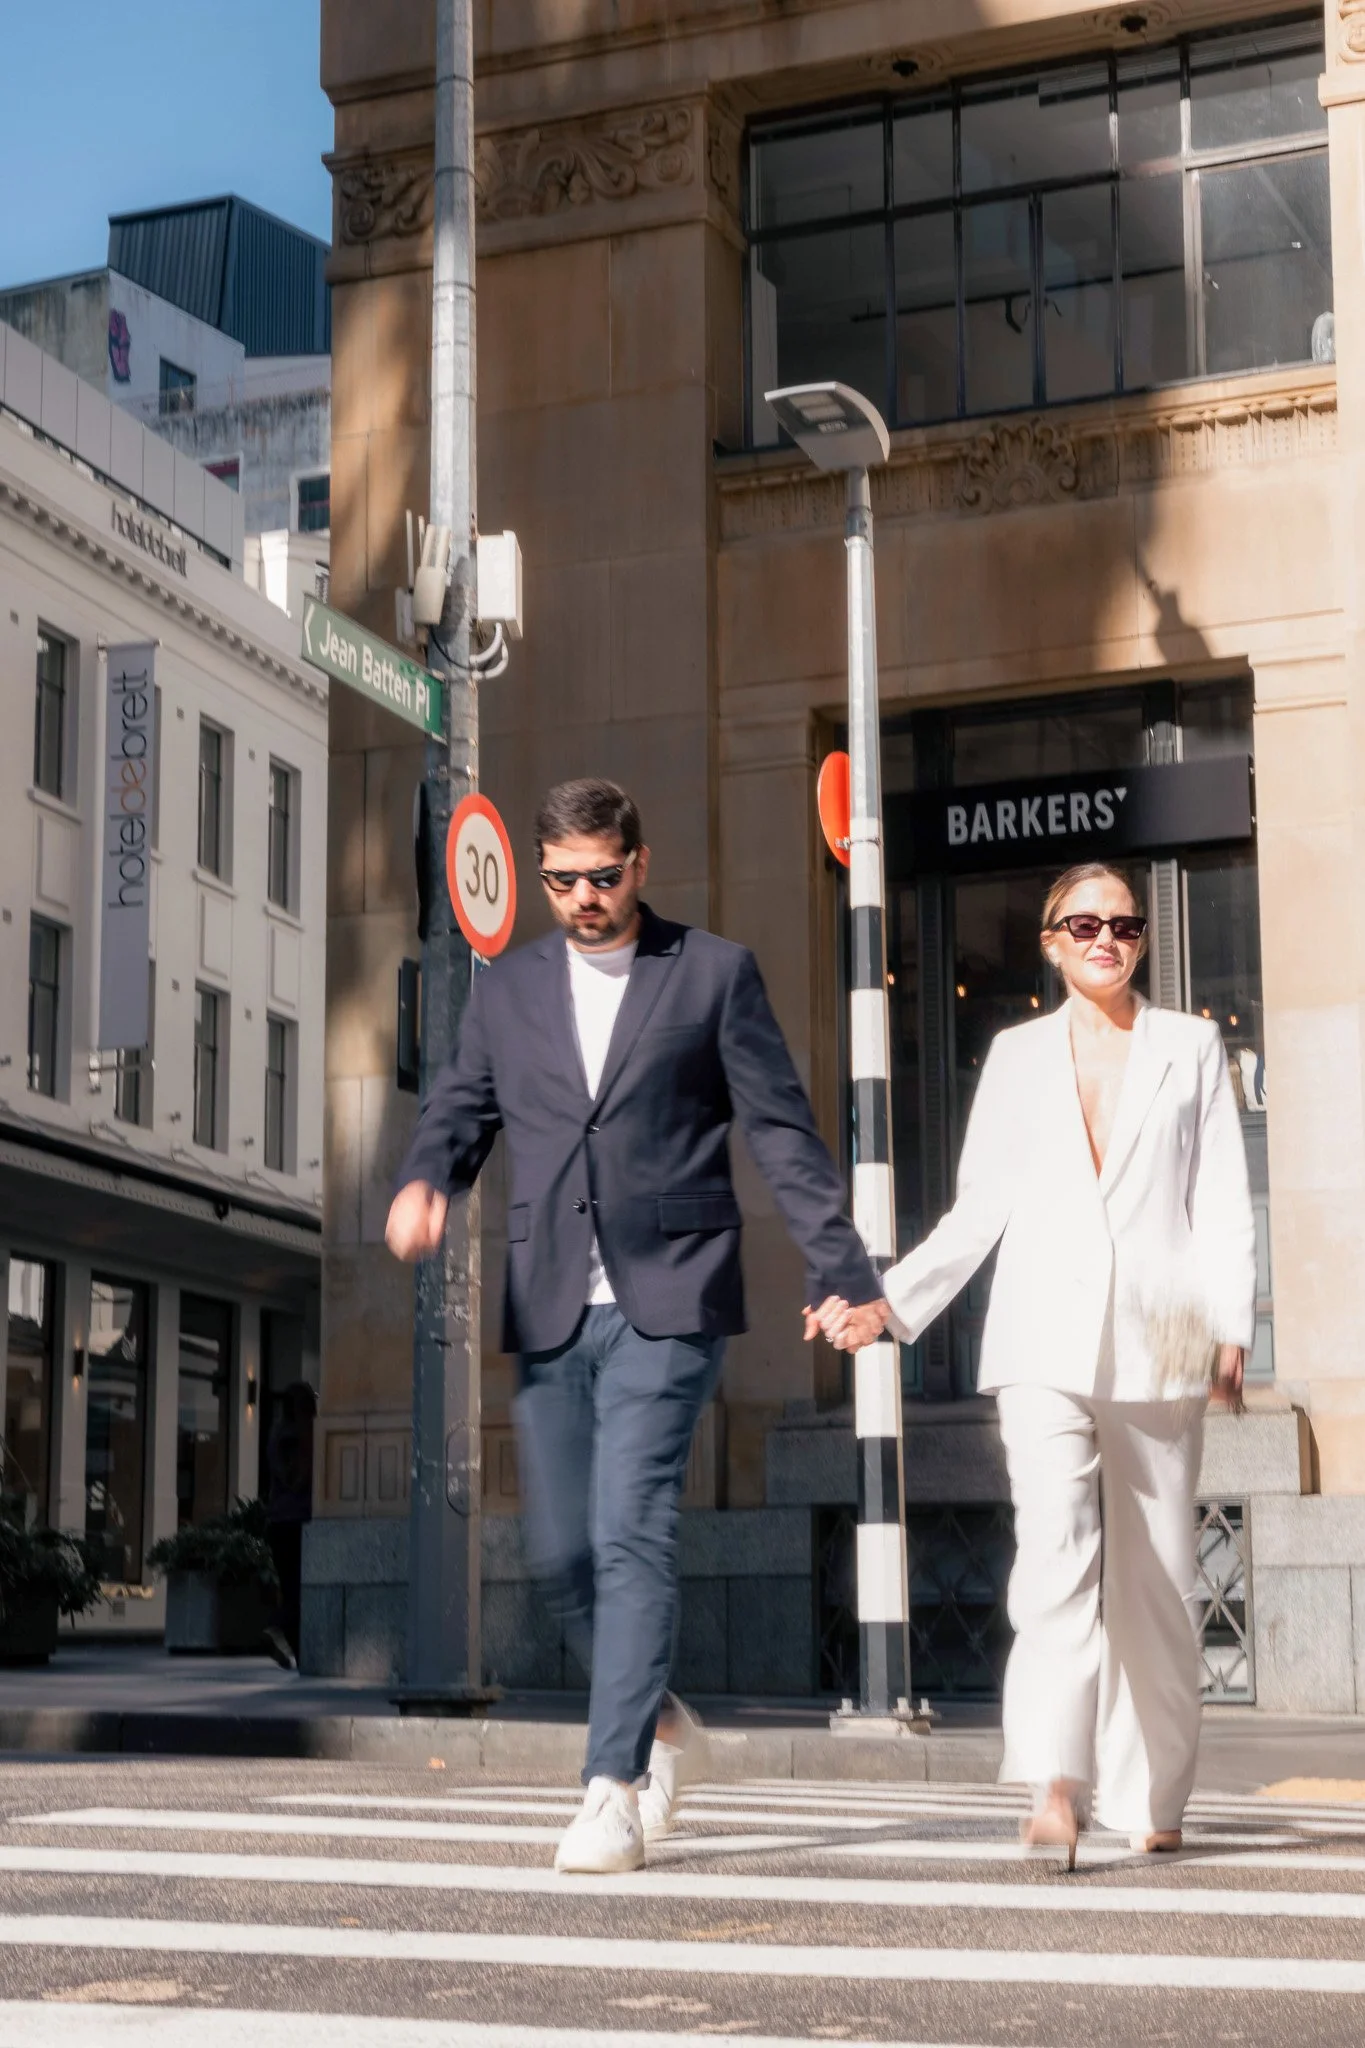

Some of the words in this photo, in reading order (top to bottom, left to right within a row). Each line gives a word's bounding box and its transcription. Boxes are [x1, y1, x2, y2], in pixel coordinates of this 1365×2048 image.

[318, 620, 358, 675] Jean
[361, 644, 412, 710] Batten
[415, 677, 431, 721] Pl
[947, 789, 1116, 846] BARKERS
[465, 844, 499, 905] 30
